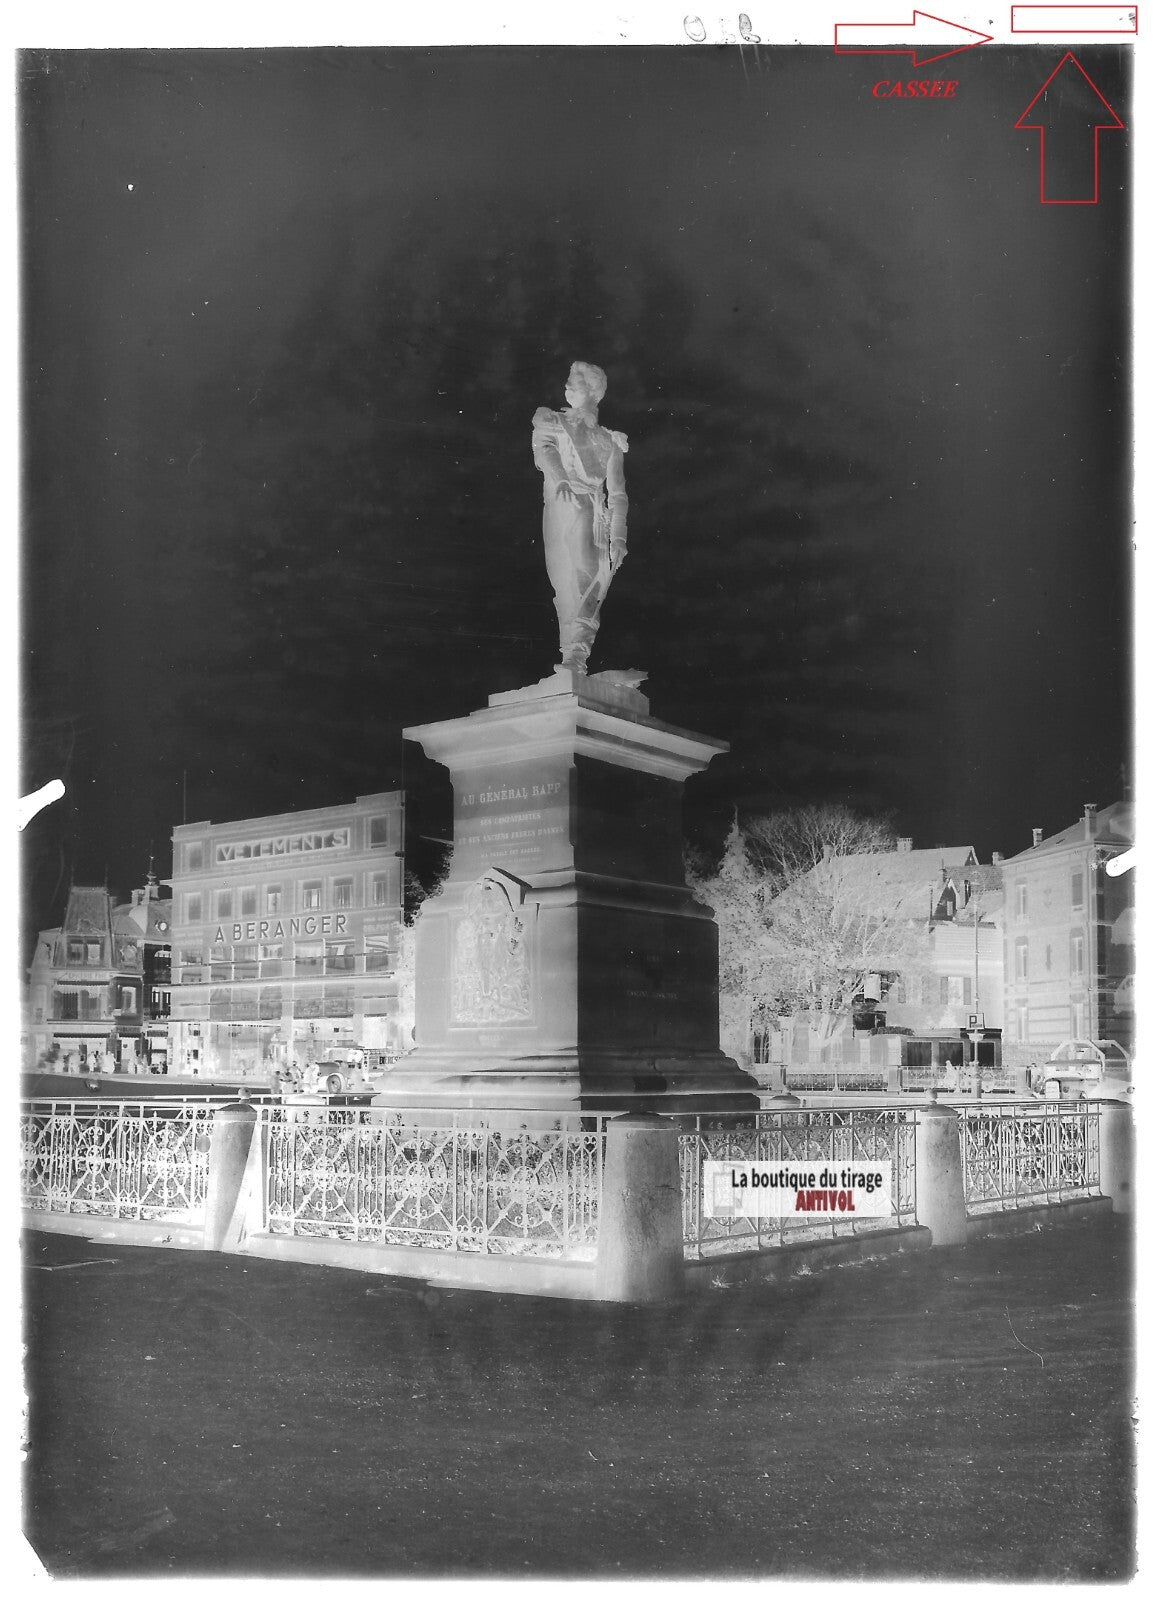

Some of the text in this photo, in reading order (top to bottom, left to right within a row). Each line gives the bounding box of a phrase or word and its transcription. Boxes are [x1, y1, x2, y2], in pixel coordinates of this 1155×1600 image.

[461, 794, 475, 806] AU
[532, 782, 561, 796] RAPP
[217, 829, 346, 861] VETEMENTS
[214, 914, 347, 943] A BERANGER
[969, 1015, 977, 1028] P
